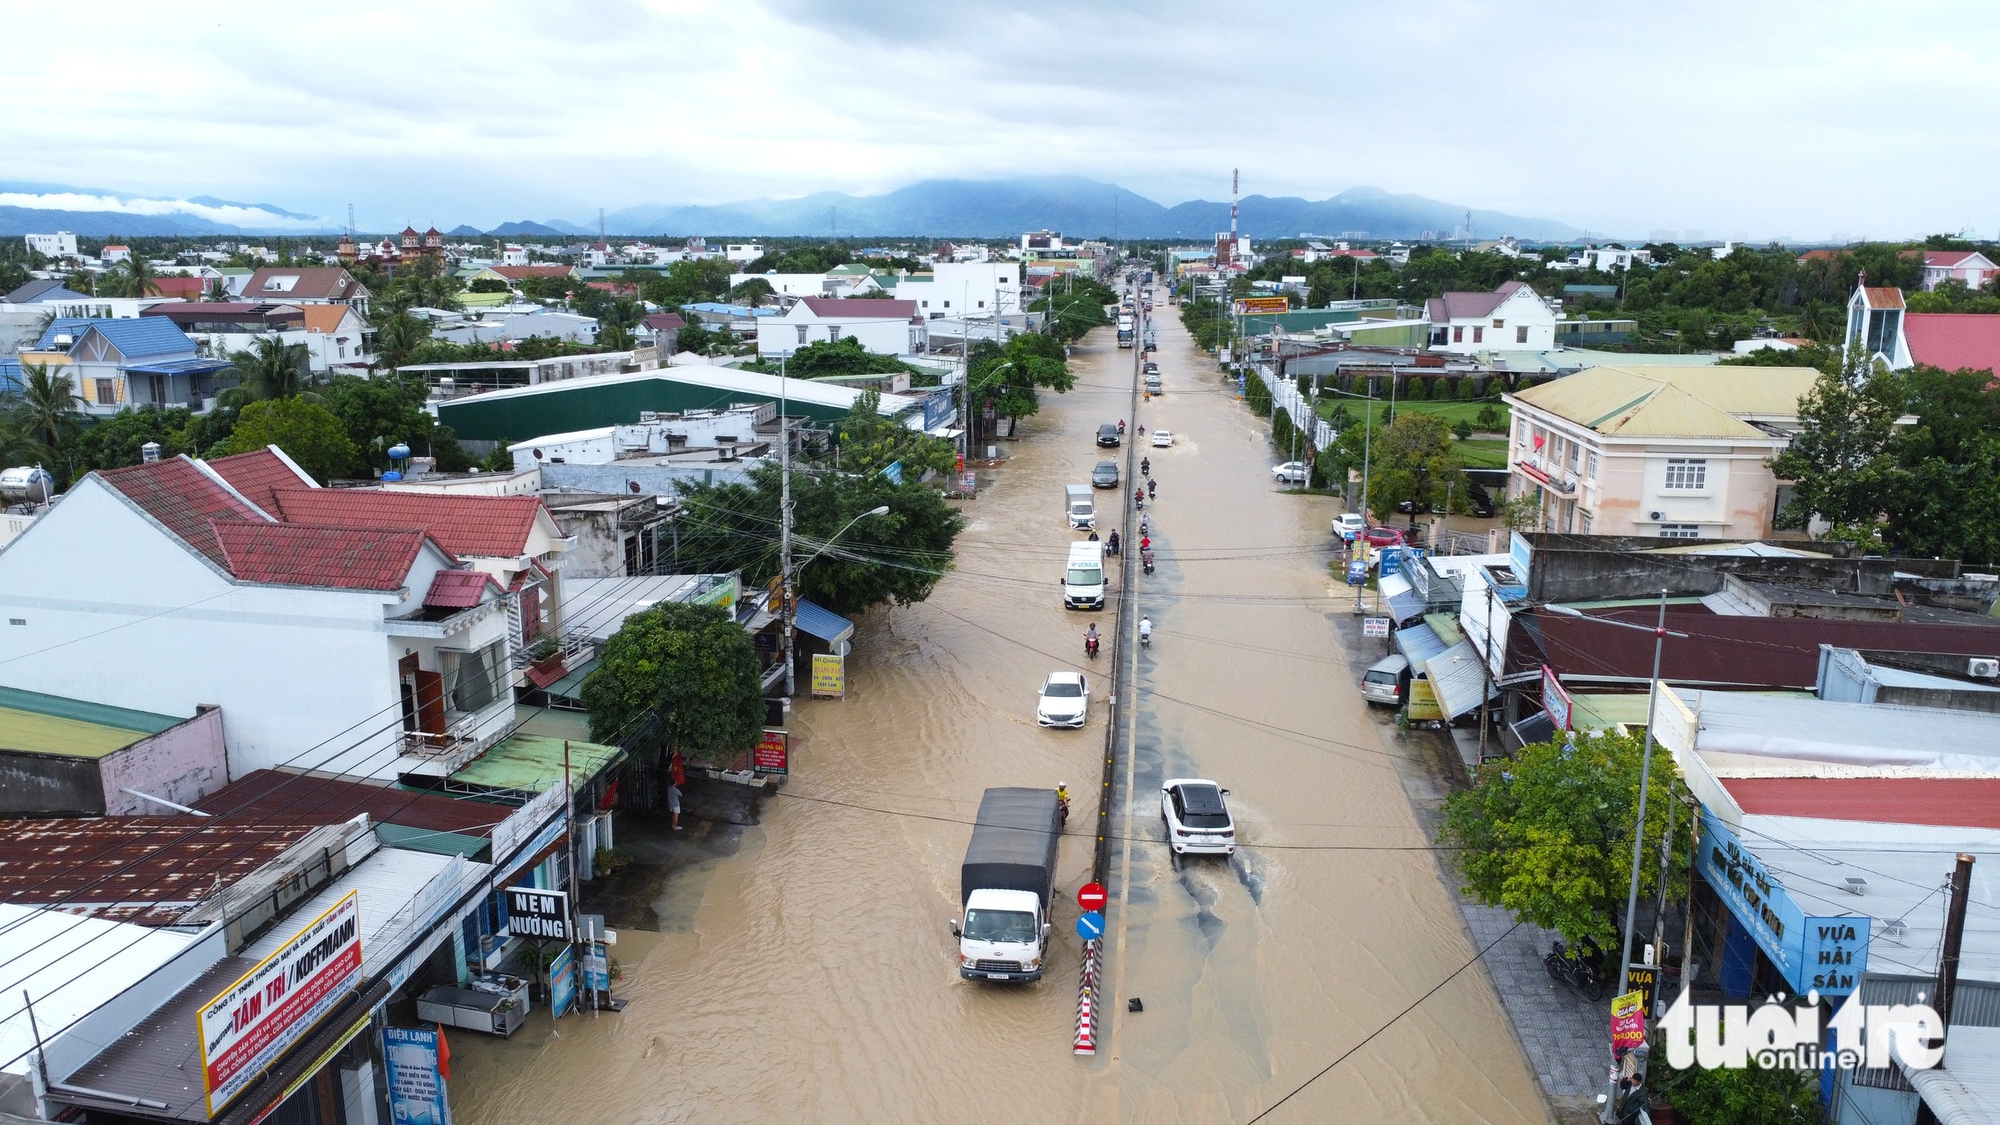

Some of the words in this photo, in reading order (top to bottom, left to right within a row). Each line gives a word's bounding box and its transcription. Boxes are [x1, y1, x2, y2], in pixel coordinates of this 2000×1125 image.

[516, 894, 555, 914] NEM
[509, 914, 563, 938] NƯỚNG
[1818, 924, 1856, 943] VỰA
[1818, 946, 1852, 965] HẢI
[232, 985, 263, 1034] TÂM
[264, 965, 287, 1008] TRÍ
[294, 914, 355, 983] KOFFMANN
[1628, 970, 1652, 985] VỰA
[1814, 969, 1853, 988] SẢN
[207, 996, 227, 1020] CÔNG
[229, 991, 235, 1002] TY
[238, 976, 253, 995] TNHH
[255, 956, 279, 982] THƯƠNG
[388, 1028, 408, 1042] ĐIỆN
[410, 1032, 432, 1043] LẠNH
